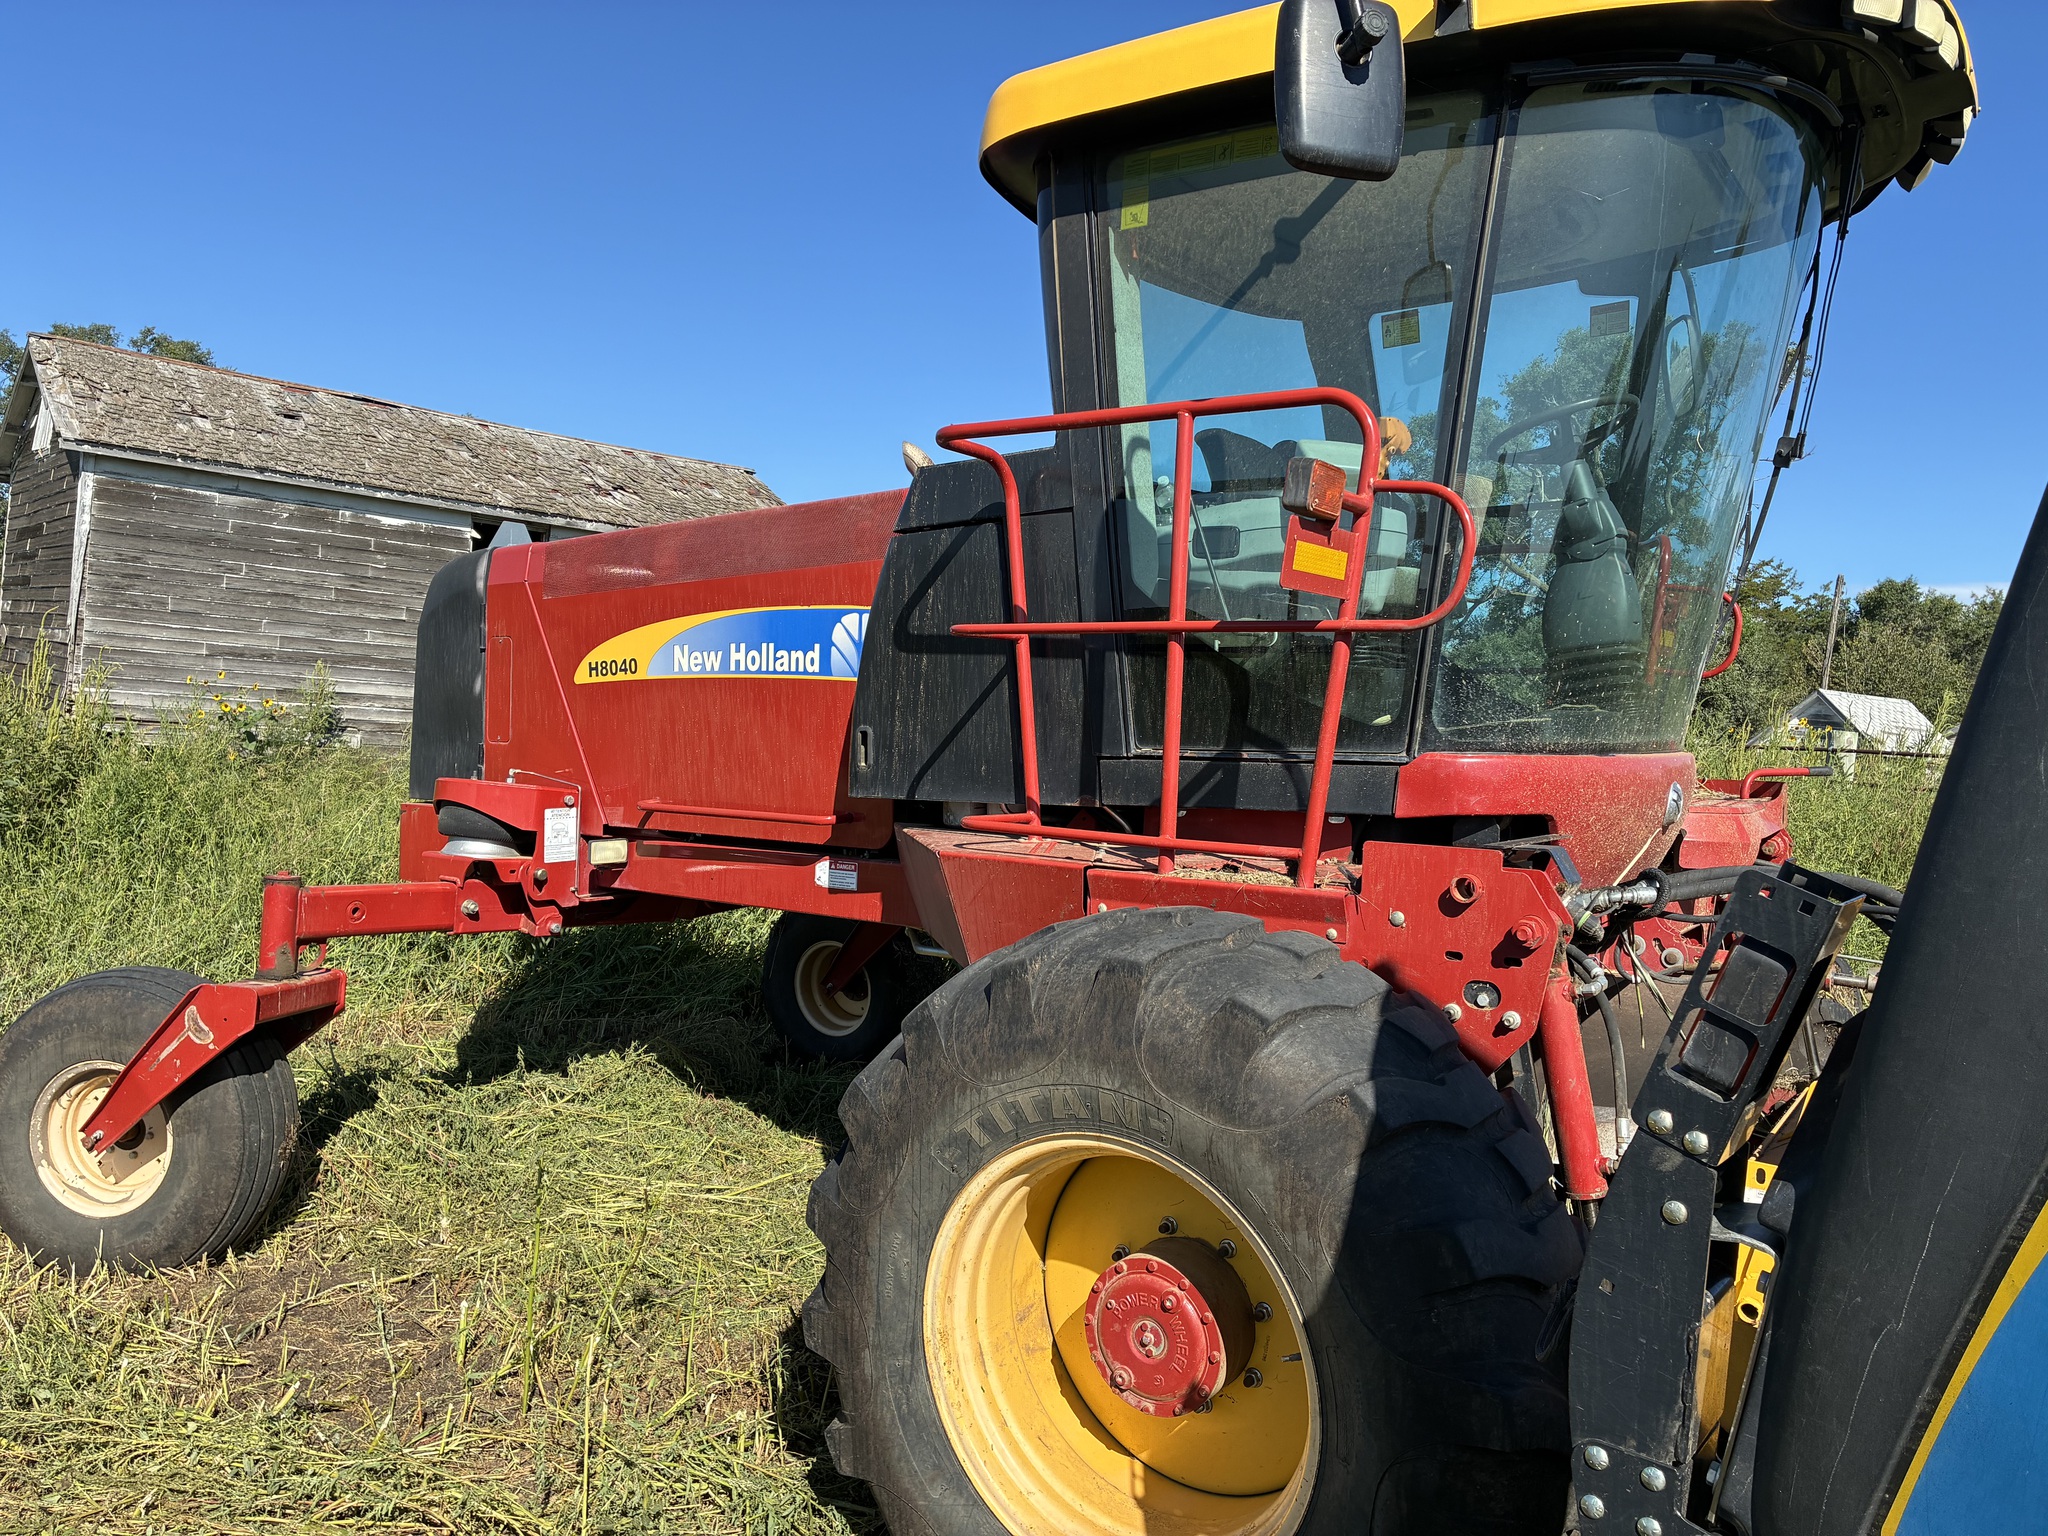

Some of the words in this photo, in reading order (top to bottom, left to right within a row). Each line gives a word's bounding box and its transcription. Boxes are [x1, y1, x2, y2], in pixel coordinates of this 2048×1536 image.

[588, 658, 638, 678] H8040
[673, 644, 722, 673] New
[730, 642, 820, 673] Holland
[836, 863, 855, 871] DANGER
[953, 1086, 1141, 1148] TITAN
[1112, 1292, 1159, 1319] POWER
[1169, 1315, 1189, 1374] WHEEL
